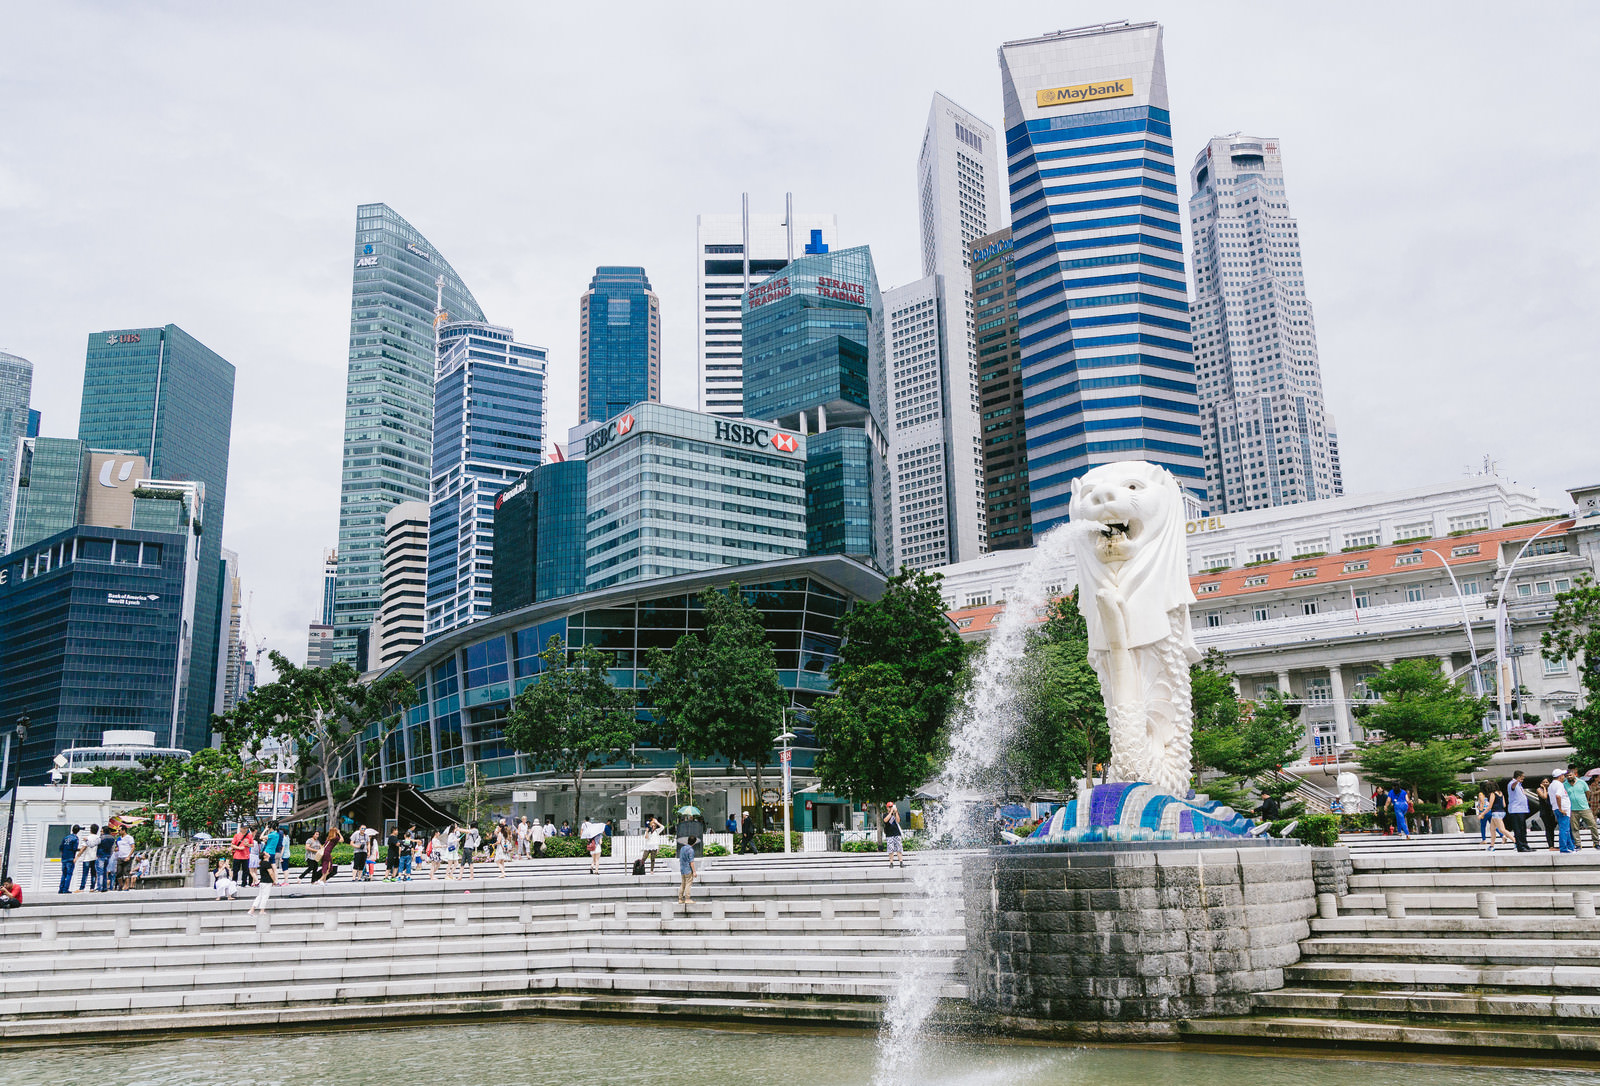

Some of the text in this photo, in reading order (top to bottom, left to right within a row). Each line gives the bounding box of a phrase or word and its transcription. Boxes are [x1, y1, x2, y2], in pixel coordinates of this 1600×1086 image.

[1057, 82, 1124, 99] Maybank
[356, 257, 378, 267] ANZ
[748, 277, 789, 299] STRAITS
[818, 276, 865, 293] STRAITS
[749, 286, 792, 309] TRADING
[816, 286, 865, 304] TRADING
[120, 333, 140, 343] UBS
[585, 421, 617, 455] HSBC
[715, 420, 768, 447] HSBC
[629, 806, 639, 816] M
